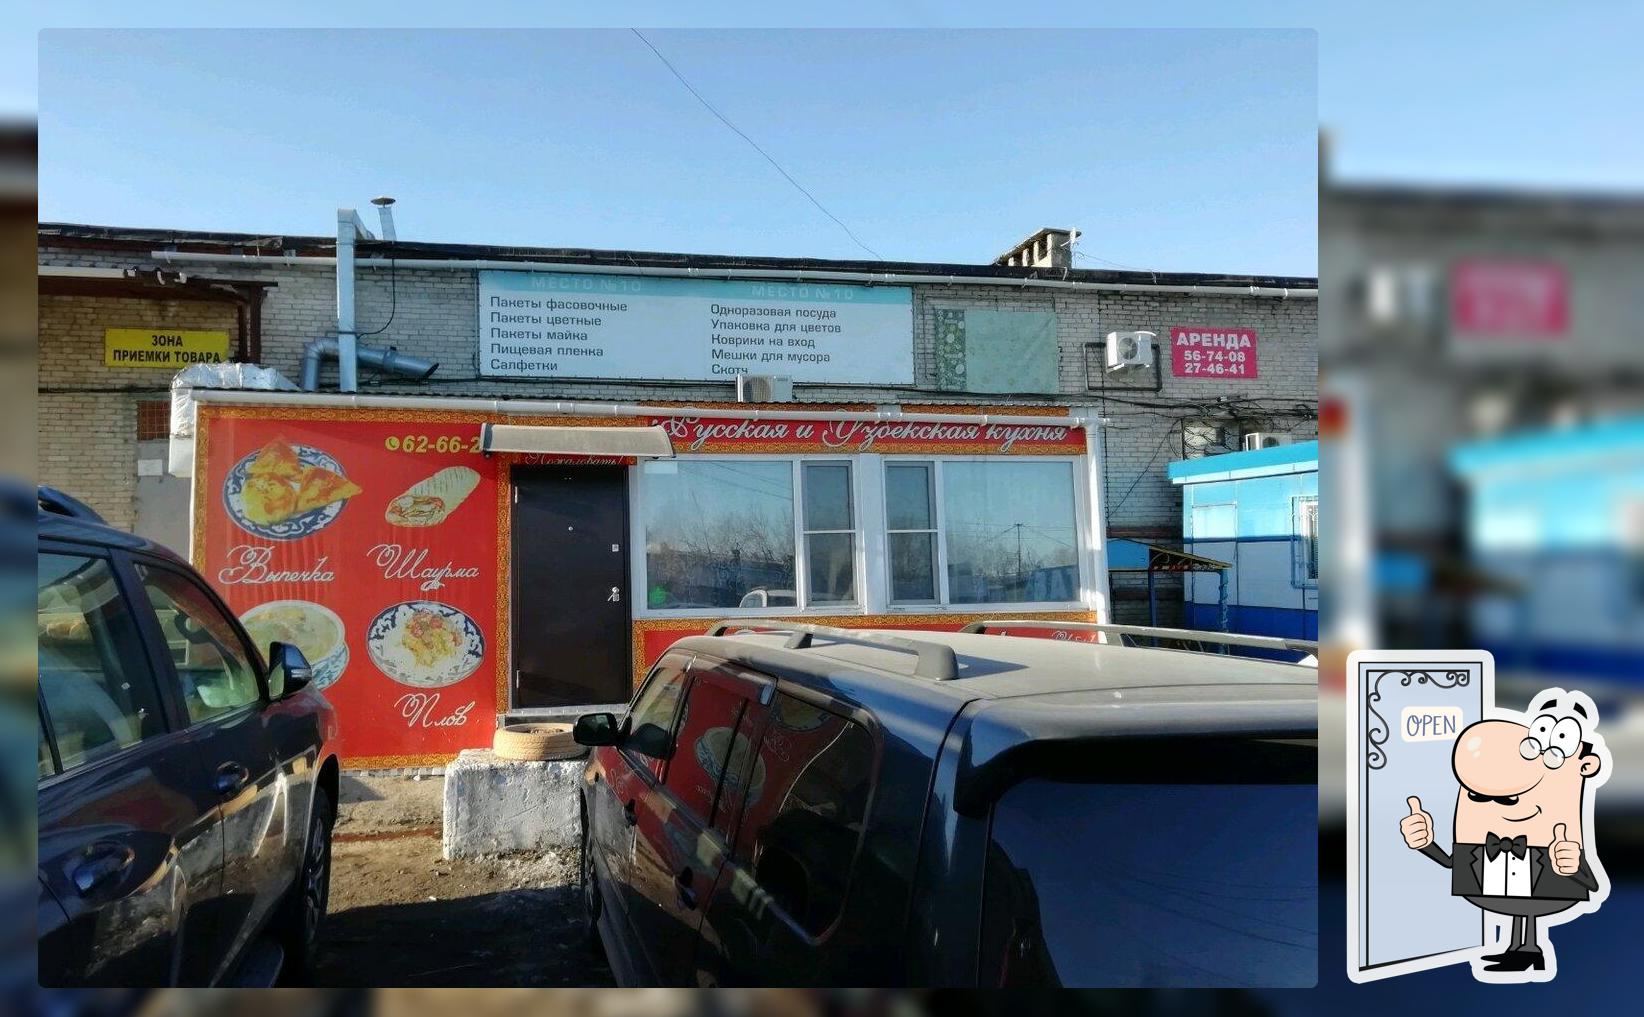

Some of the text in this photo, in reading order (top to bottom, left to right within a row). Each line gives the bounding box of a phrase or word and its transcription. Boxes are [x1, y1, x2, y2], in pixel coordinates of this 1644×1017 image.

[532, 276, 593, 290] МЕСТО
[752, 285, 809, 299] МЕСТО
[490, 296, 628, 311] Пакеты фасовочные
[710, 303, 836, 320] Одноразовая посуда
[490, 312, 602, 327] Пакеты цветные
[711, 318, 841, 334] Упаковка для цветов
[151, 335, 183, 347] ЗОНА
[490, 327, 588, 341] Пакеты майка
[711, 333, 816, 349] Коврики на вход
[1176, 332, 1251, 350] АРЕНДА
[113, 349, 221, 363] ПРИЕМКИ ТОВАРА
[490, 343, 604, 357] Пищевая пленка
[711, 349, 830, 364] Мешки для мусора
[1184, 350, 1246, 362] 56-74-08
[490, 358, 558, 372] Салфетки
[711, 364, 749, 375] Скотч
[1184, 362, 1246, 375] 27-46-41
[796, 423, 814, 439] и
[984, 415, 1067, 452] кухня
[218, 544, 335, 585] Выпечка
[367, 544, 480, 591] Шаурма
[394, 693, 476, 728] Плов
